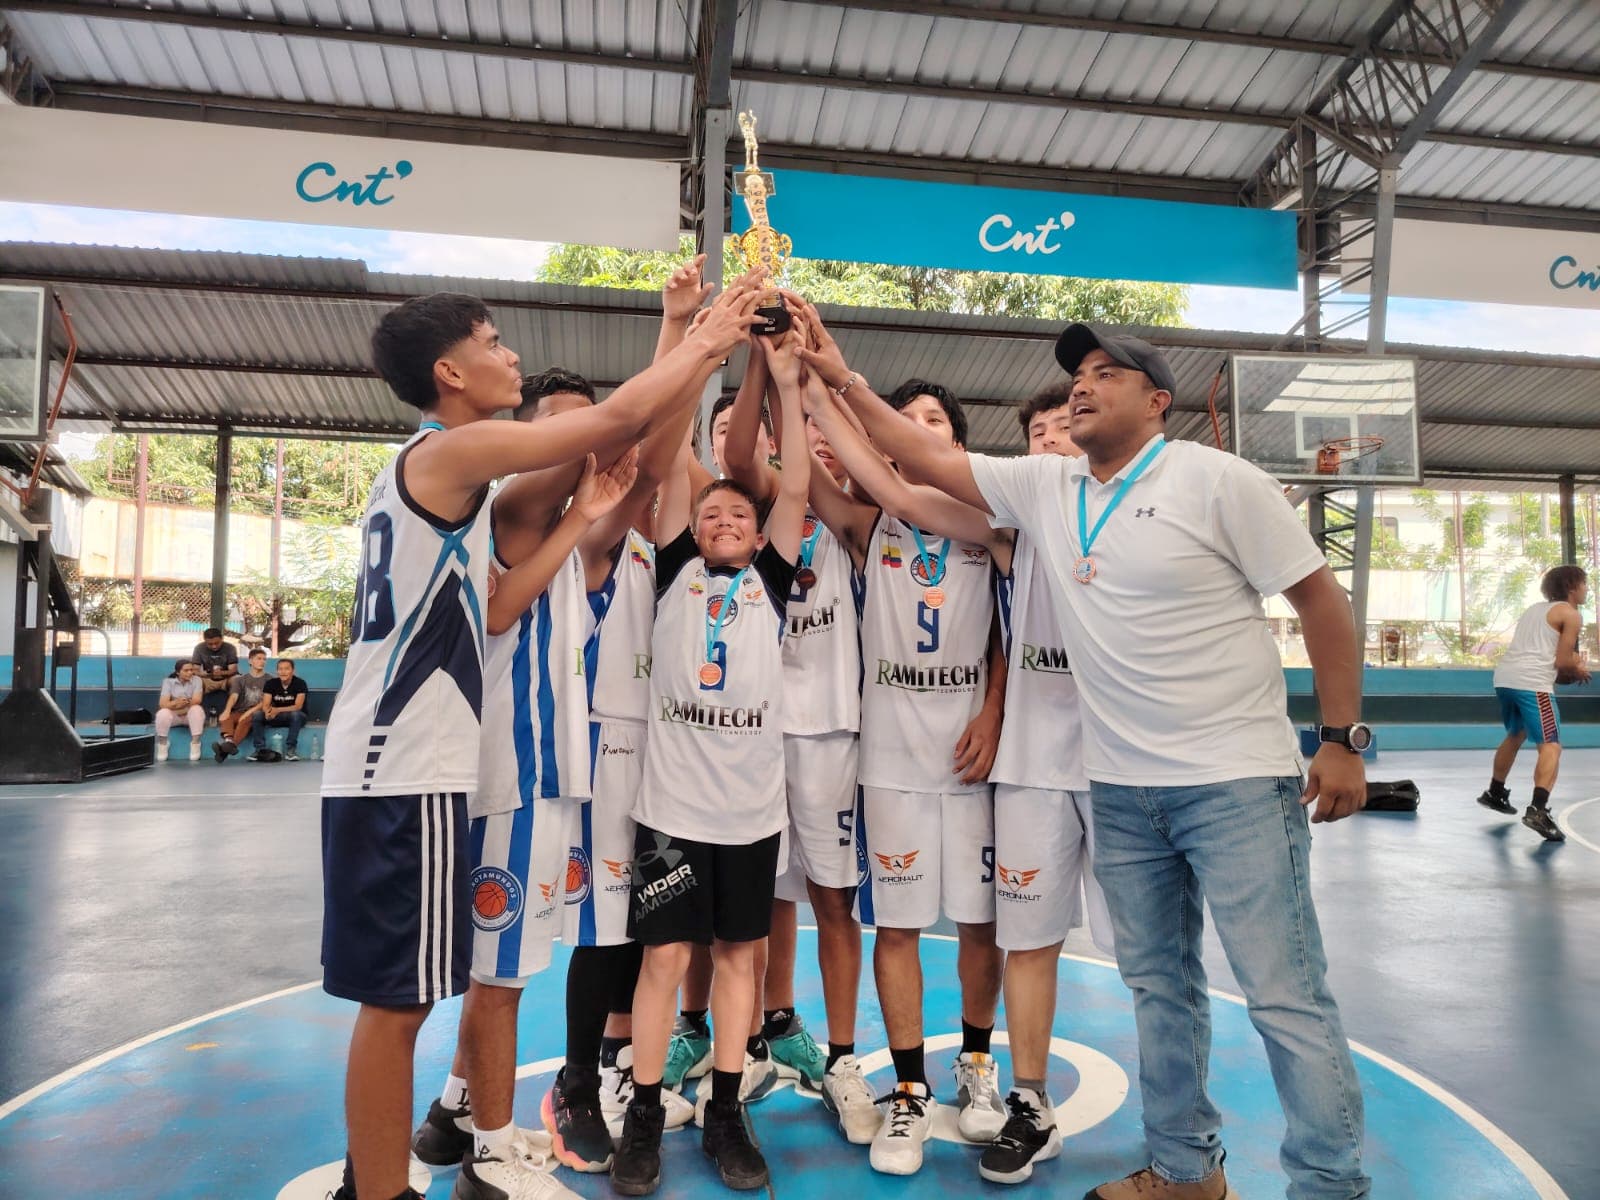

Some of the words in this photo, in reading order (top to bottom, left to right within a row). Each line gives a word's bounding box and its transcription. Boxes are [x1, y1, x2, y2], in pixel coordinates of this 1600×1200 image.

[1549, 255, 1600, 292] Cn
[917, 600, 939, 653] 9
[1019, 643, 1069, 671] RAM
